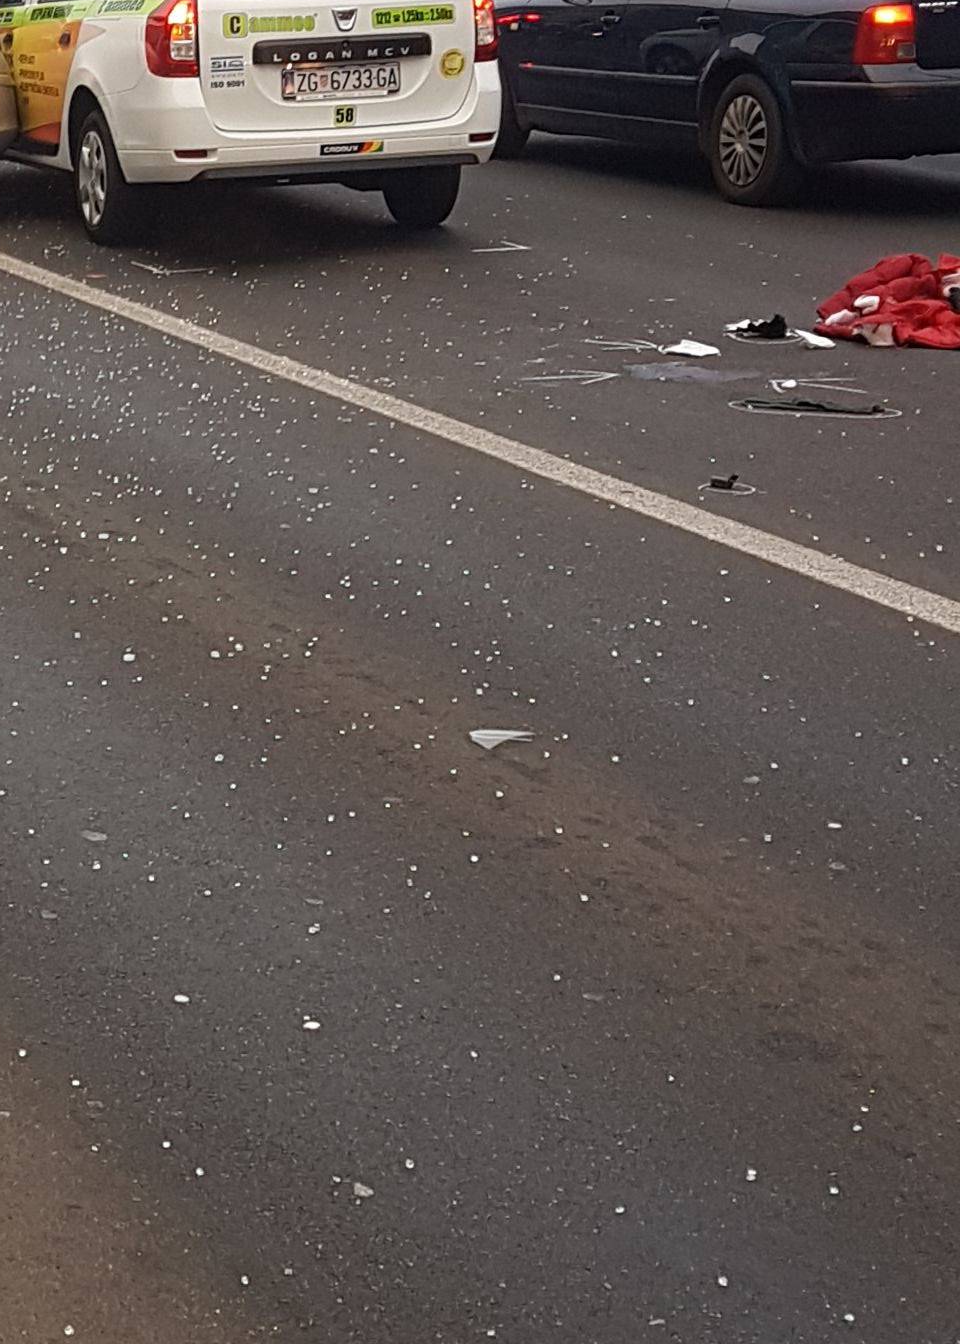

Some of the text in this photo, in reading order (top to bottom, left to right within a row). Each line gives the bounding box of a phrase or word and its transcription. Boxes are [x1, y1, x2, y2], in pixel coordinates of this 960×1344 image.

[273, 47, 410, 62] LOGAN MCV
[297, 72, 319, 92] ZG
[335, 107, 354, 123] 58
